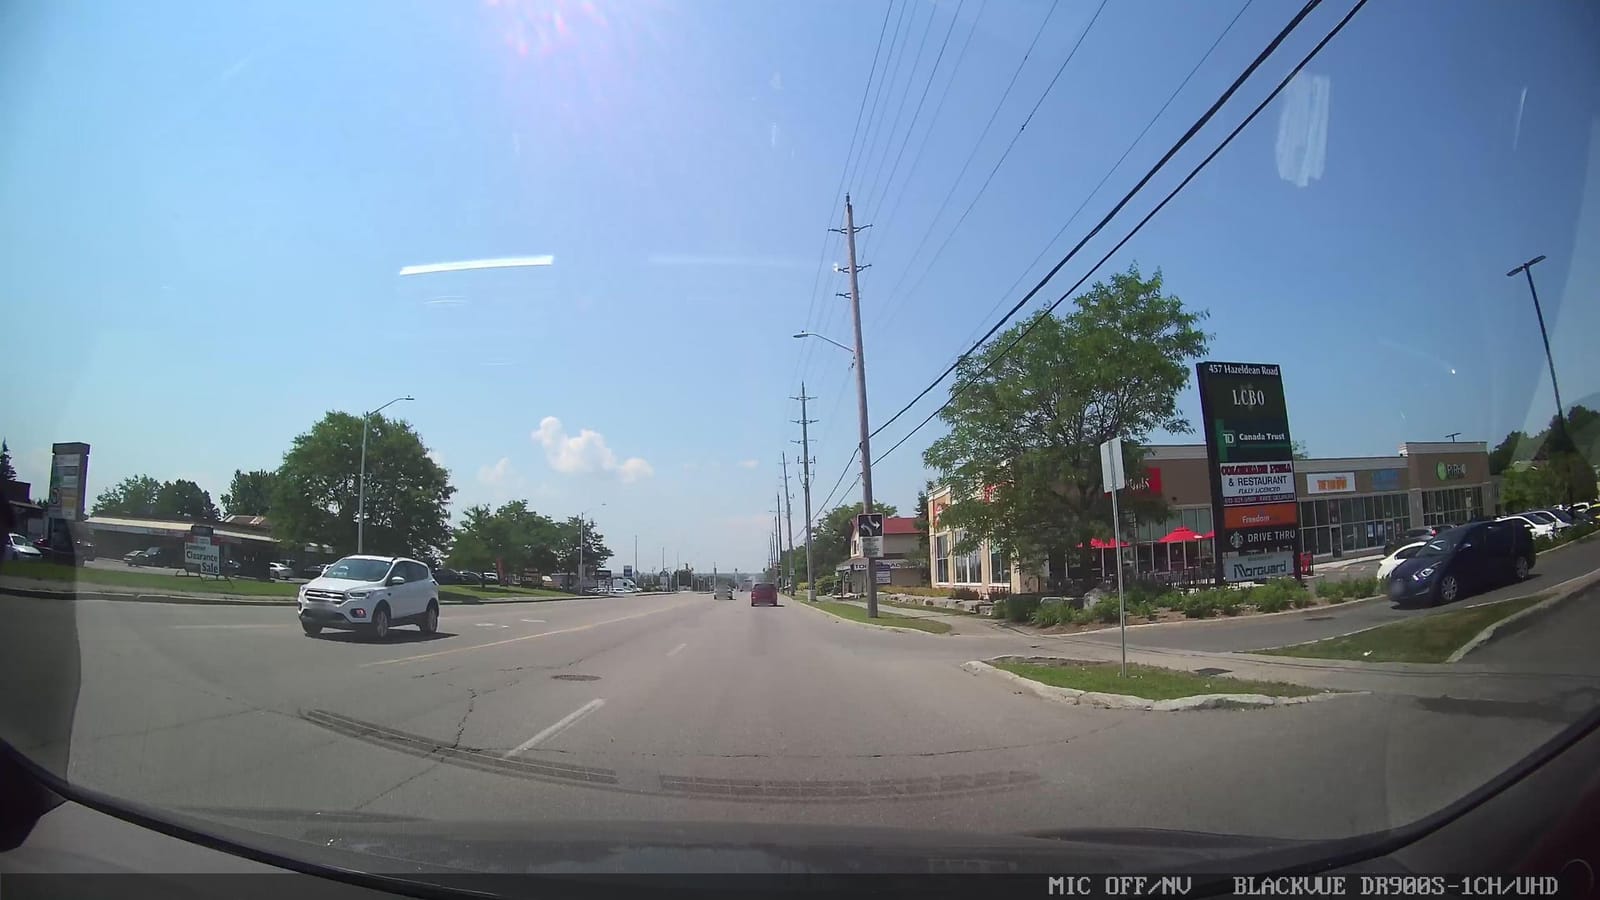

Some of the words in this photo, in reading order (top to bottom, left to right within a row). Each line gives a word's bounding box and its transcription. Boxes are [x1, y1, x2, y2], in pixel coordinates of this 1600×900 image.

[1208, 364, 1222, 374] 457
[1223, 364, 1260, 375] Hazeldean
[1261, 366, 1279, 376] Road
[1232, 389, 1265, 406] LCBO
[1223, 433, 1235, 444] TD
[1239, 433, 1265, 441] Canada
[1266, 433, 1285, 441] Trust
[1228, 477, 1234, 487] &
[1237, 475, 1288, 487] RESTAURANT
[1242, 514, 1270, 524] Freedom
[1247, 532, 1272, 543] DRIVE
[1274, 530, 1296, 540] THRU
[186, 551, 217, 562] Clearance
[201, 562, 218, 573] Sale
[1233, 560, 1287, 578] Morguard
